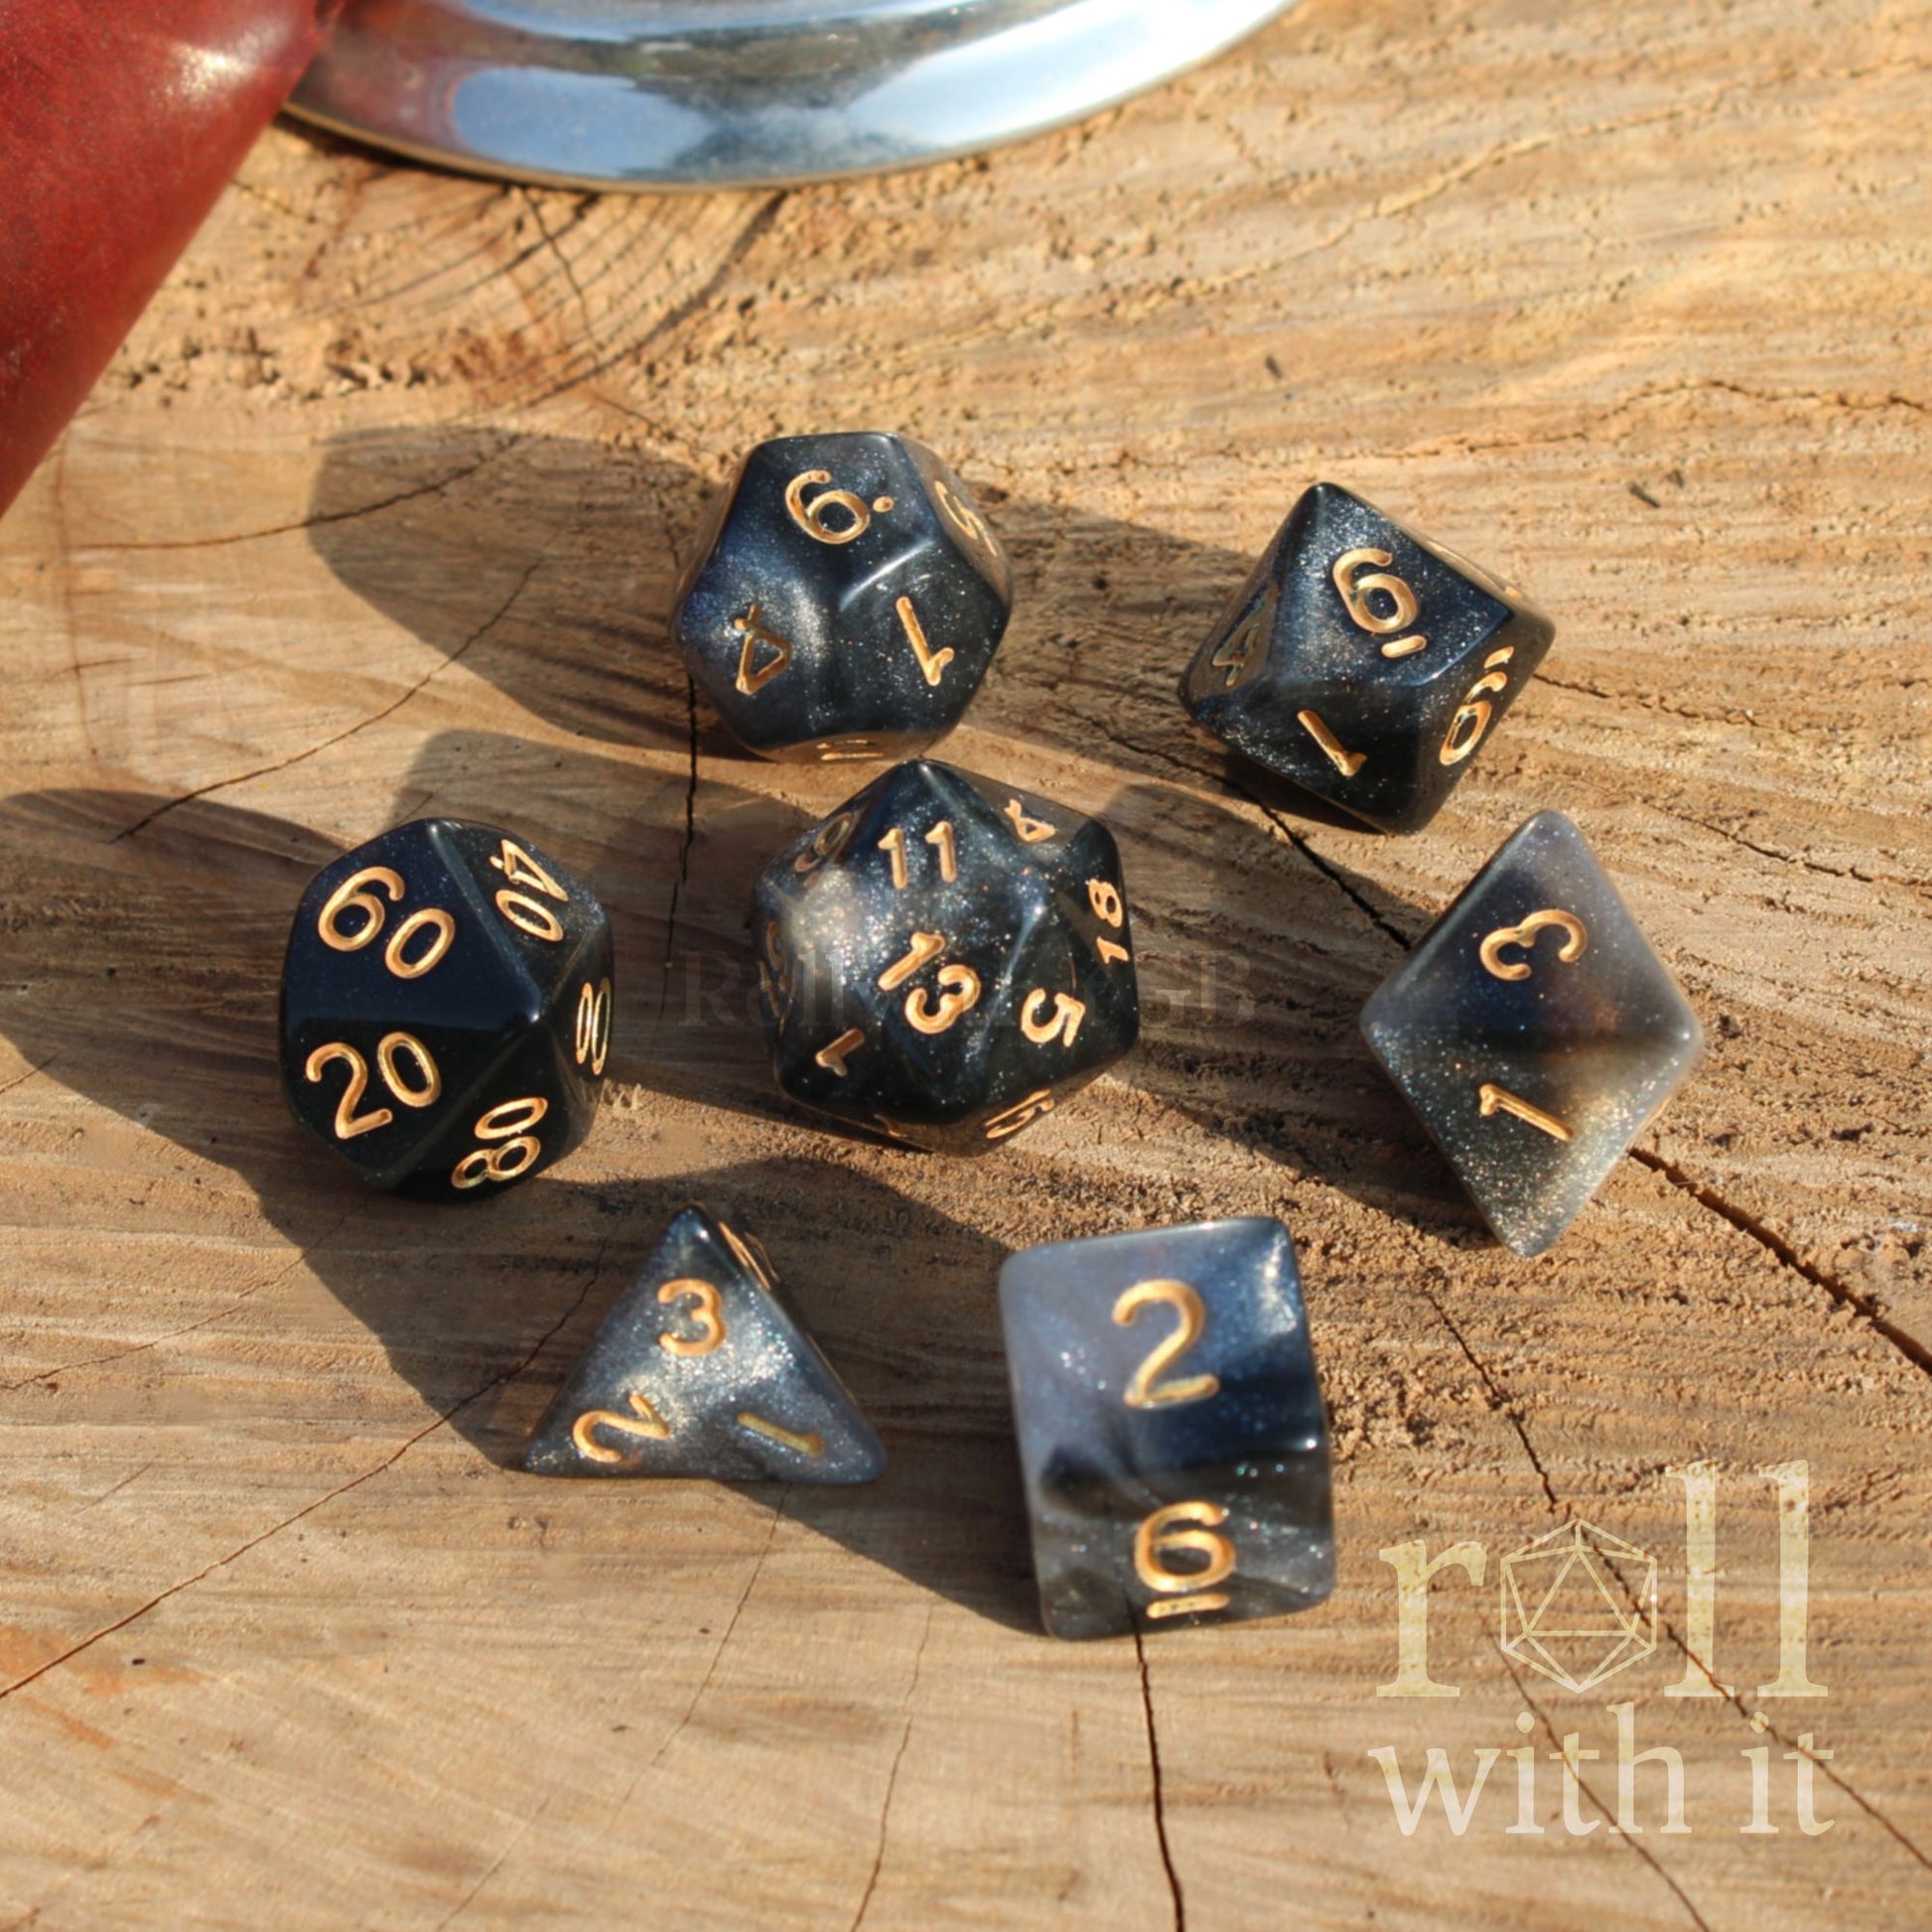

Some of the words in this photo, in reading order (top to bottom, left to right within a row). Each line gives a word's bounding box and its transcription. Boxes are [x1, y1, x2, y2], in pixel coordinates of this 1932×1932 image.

[734, 603, 794, 695] 4
[896, 597, 955, 686] 1
[1297, 709, 1368, 777] 1
[879, 820, 957, 890] 11
[1004, 798, 1056, 844] 4
[318, 866, 455, 979] 60
[489, 839, 569, 941] 40
[878, 931, 982, 1035] 13
[1479, 908, 1588, 981] 3
[575, 977, 612, 1075] 00
[815, 1028, 866, 1078] 1
[1021, 988, 1086, 1047] 5
[306, 1032, 442, 1141] 20
[1479, 1083, 1575, 1143] 1
[451, 1096, 549, 1189] 80
[656, 1277, 727, 1357] 3
[1111, 1278, 1221, 1411] 2
[572, 1392, 672, 1464] 2
[737, 1411, 825, 1458] 1
